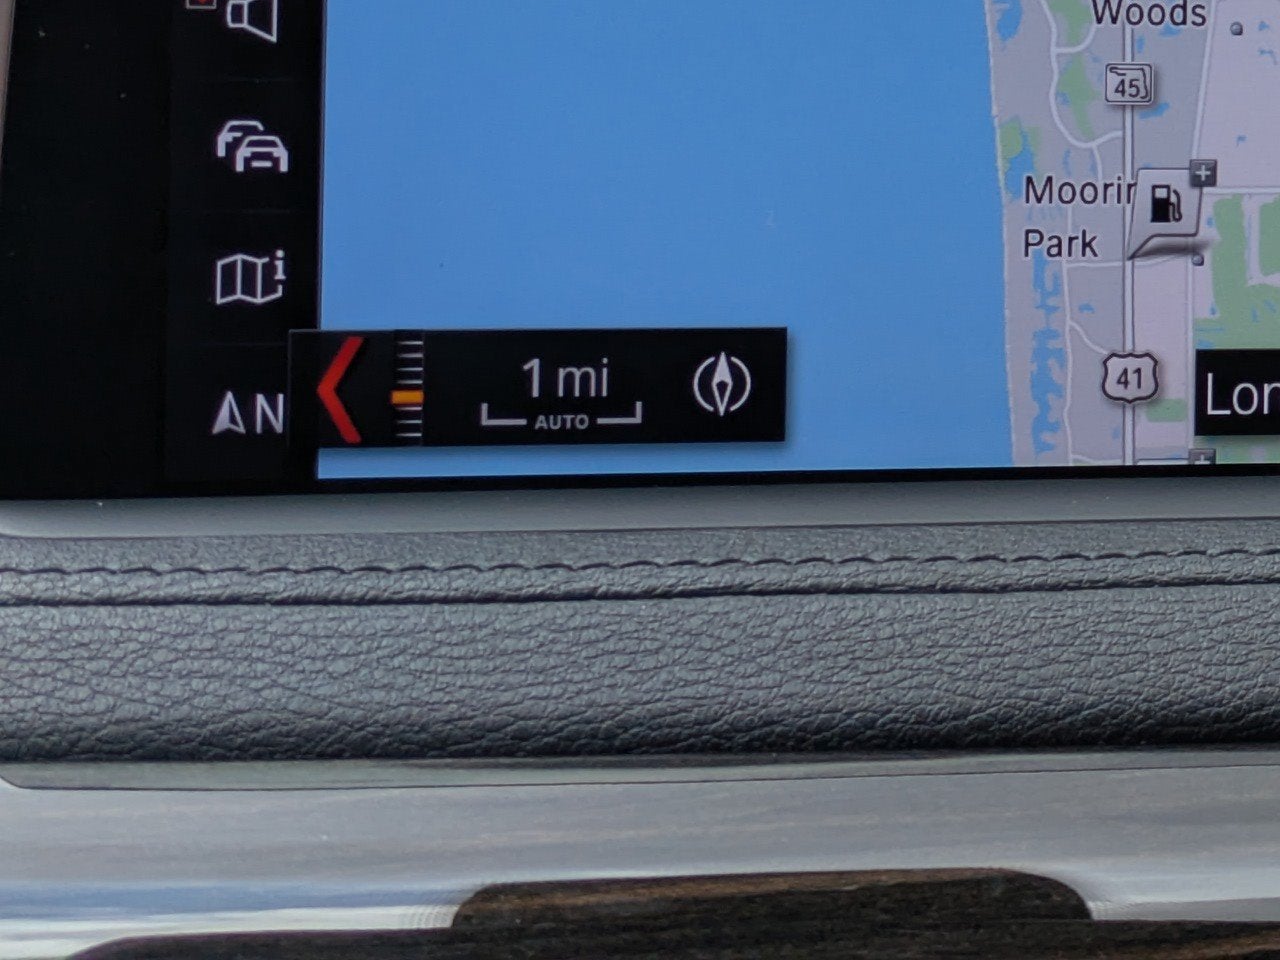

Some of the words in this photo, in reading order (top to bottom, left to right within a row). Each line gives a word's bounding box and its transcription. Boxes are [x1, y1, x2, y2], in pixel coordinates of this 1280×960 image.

[1114, 77, 1141, 99] 45
[1024, 228, 1099, 257] Park
[522, 358, 541, 398] 1
[557, 357, 610, 398] mi
[1117, 367, 1143, 390] 41
[534, 413, 591, 430] AUTO
